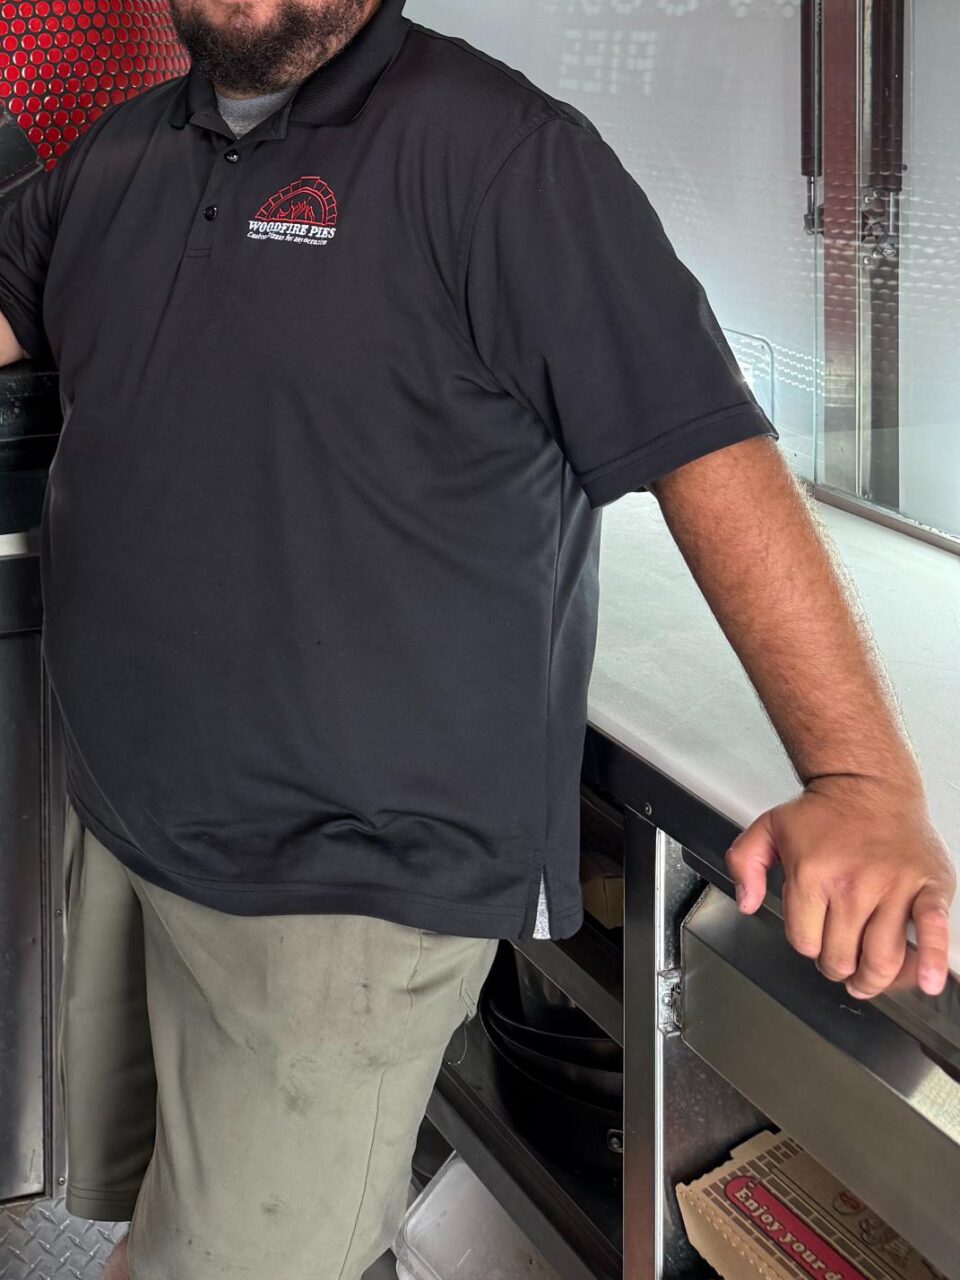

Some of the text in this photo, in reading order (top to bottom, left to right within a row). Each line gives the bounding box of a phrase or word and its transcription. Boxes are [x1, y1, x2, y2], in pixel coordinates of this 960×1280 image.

[248, 220, 336, 238] WOODFIRE PIES
[779, 1232, 826, 1269] your
